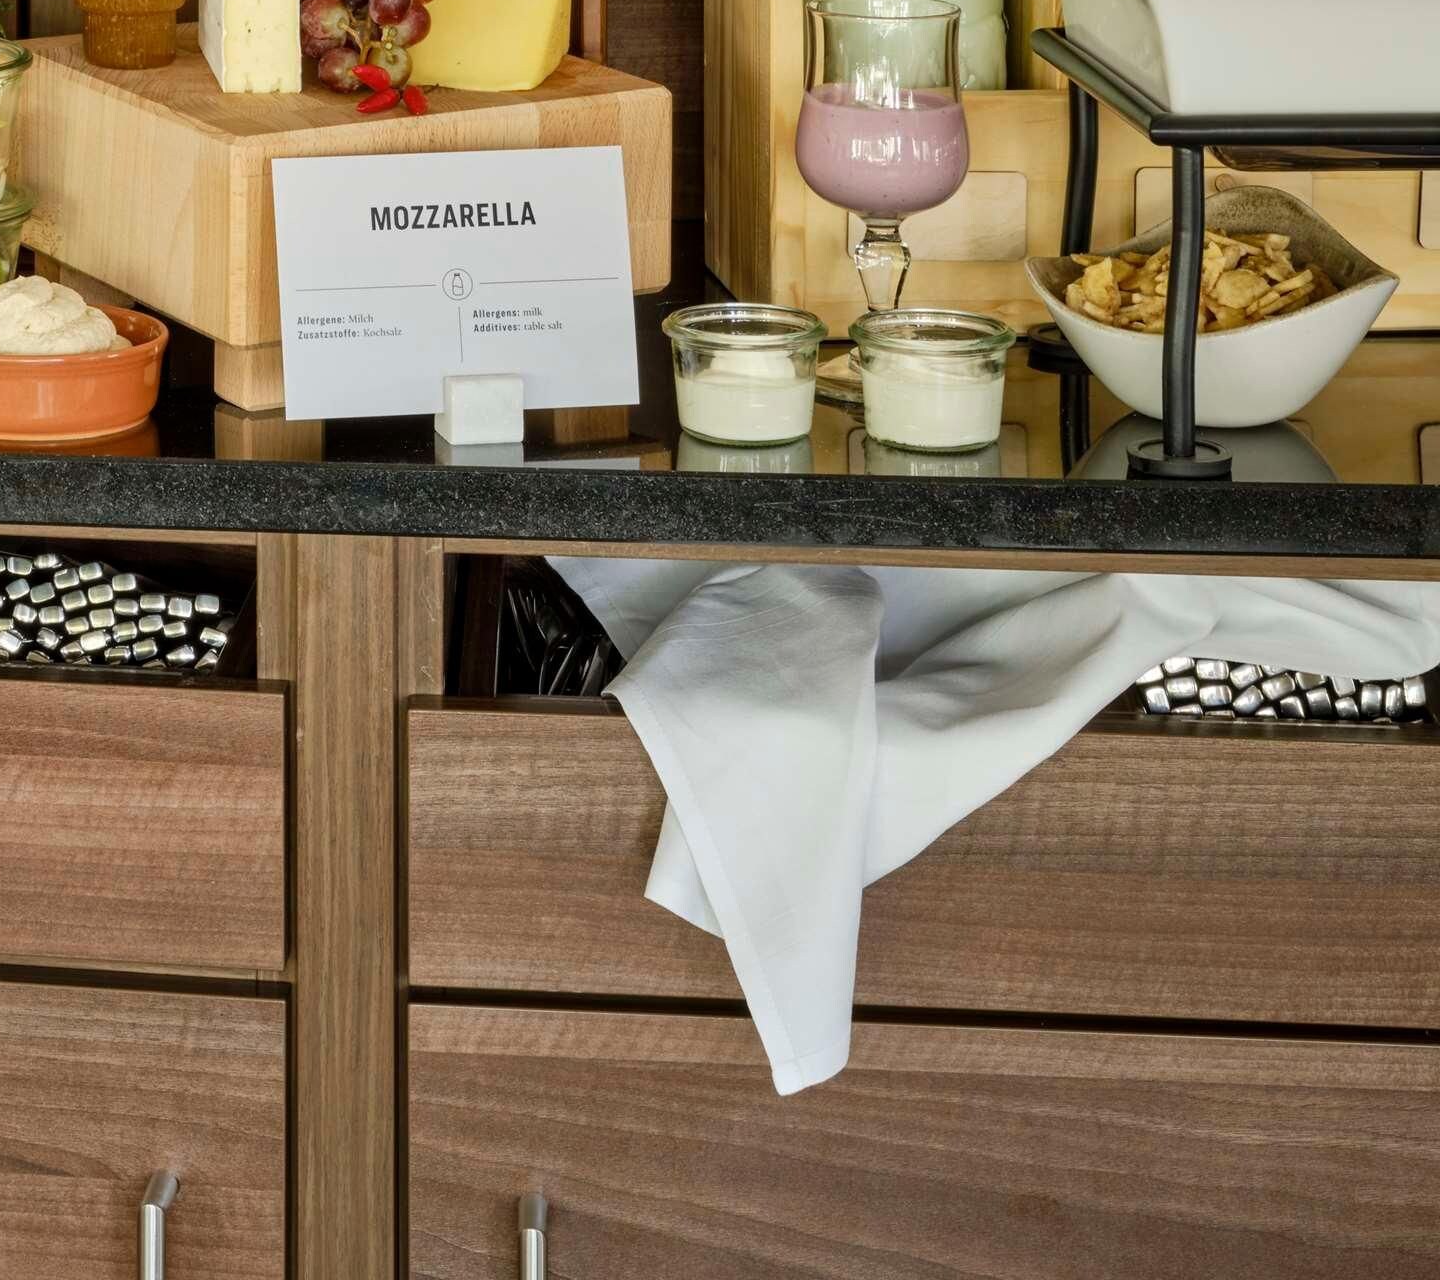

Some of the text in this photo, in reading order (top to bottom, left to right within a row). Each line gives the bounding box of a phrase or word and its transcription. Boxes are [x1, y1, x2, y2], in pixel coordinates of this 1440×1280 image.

[370, 200, 536, 231] MOZZARELLA
[472, 306, 542, 320] Allergens: milk
[296, 313, 374, 328] Allergene: Milch
[471, 321, 562, 333] Additives: table salt
[297, 328, 360, 340] Zusatzstoffe:
